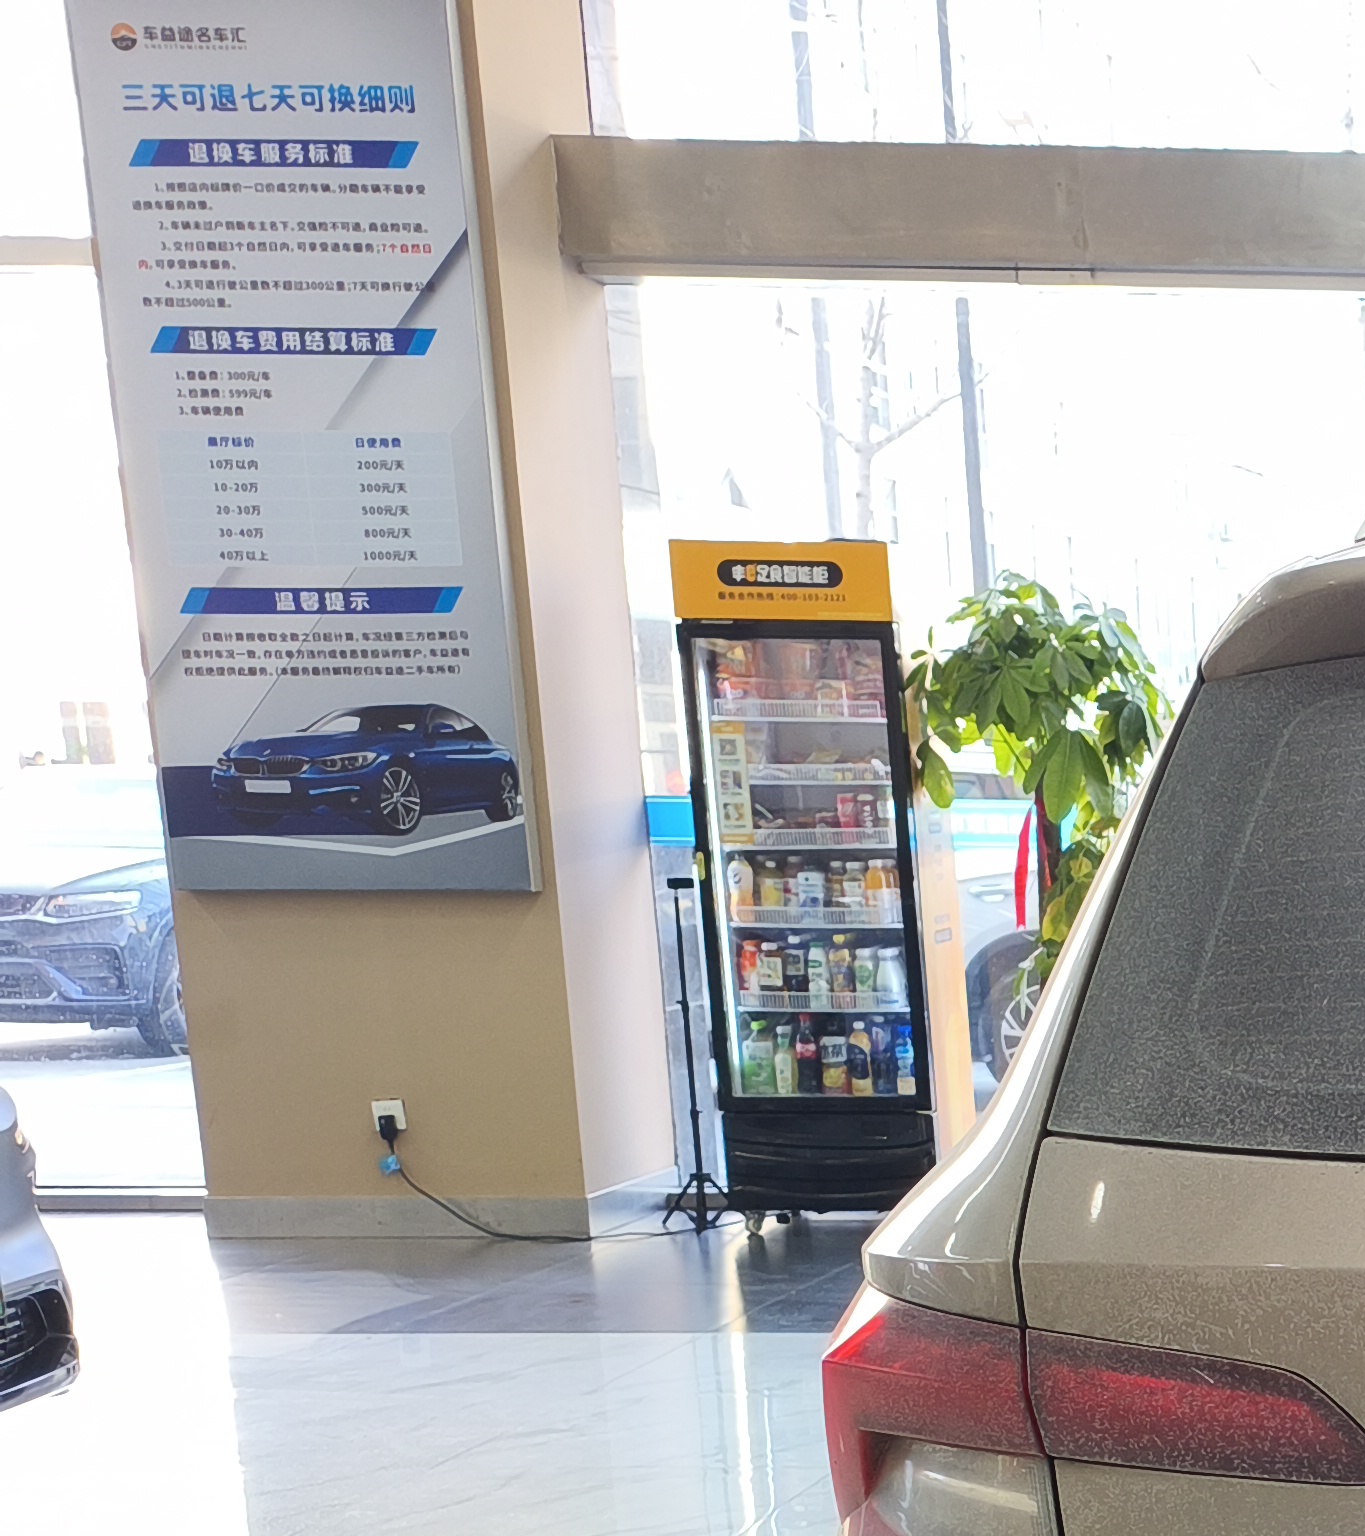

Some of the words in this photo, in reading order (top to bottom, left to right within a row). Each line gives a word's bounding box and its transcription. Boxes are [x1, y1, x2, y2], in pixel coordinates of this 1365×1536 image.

[122, 83, 416, 114] 三天可退七天可换细则
[188, 143, 354, 164] 退换车服务标准
[188, 330, 395, 353] 退换车费用结算标准
[209, 459, 259, 471] 10万以内
[356, 460, 405, 472] 200元/天
[213, 482, 259, 494] 10-20万
[359, 483, 408, 494] 300元/天
[216, 505, 261, 517] 20-30万
[361, 505, 410, 517] 500元/天
[218, 528, 264, 539] 30-40万
[363, 528, 412, 540] 800元/天
[219, 551, 270, 562] 40万以上
[363, 550, 419, 562] 1000元/天
[274, 592, 370, 612] 温馨提示
